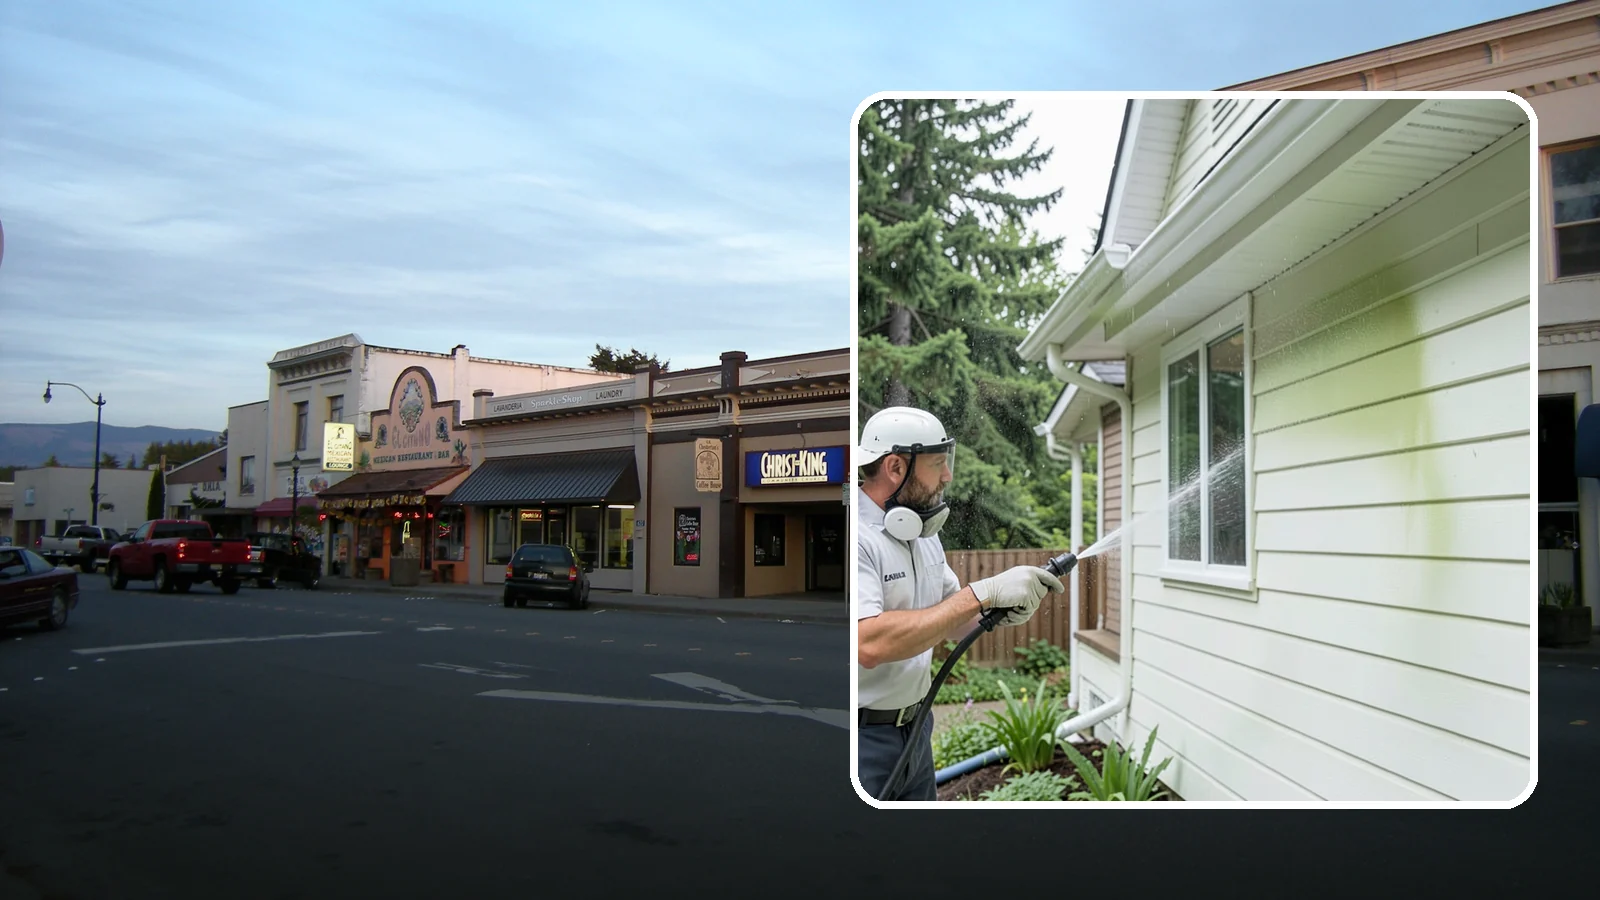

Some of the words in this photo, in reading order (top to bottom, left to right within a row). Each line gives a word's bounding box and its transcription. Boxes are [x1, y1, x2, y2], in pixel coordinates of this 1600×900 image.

[595, 389, 623, 400] LAUNDRY
[493, 402, 523, 413] LAVANDERIA
[530, 396, 561, 409] Sparkle
[561, 394, 583, 405] Shop
[373, 455, 396, 464] MEXICAN
[397, 451, 433, 462] RESTAURANT
[437, 450, 450, 459] BAR
[760, 451, 798, 478] CHRIST
[800, 450, 827, 476] KING
[696, 481, 709, 489] Coffee
[710, 481, 722, 489] House
